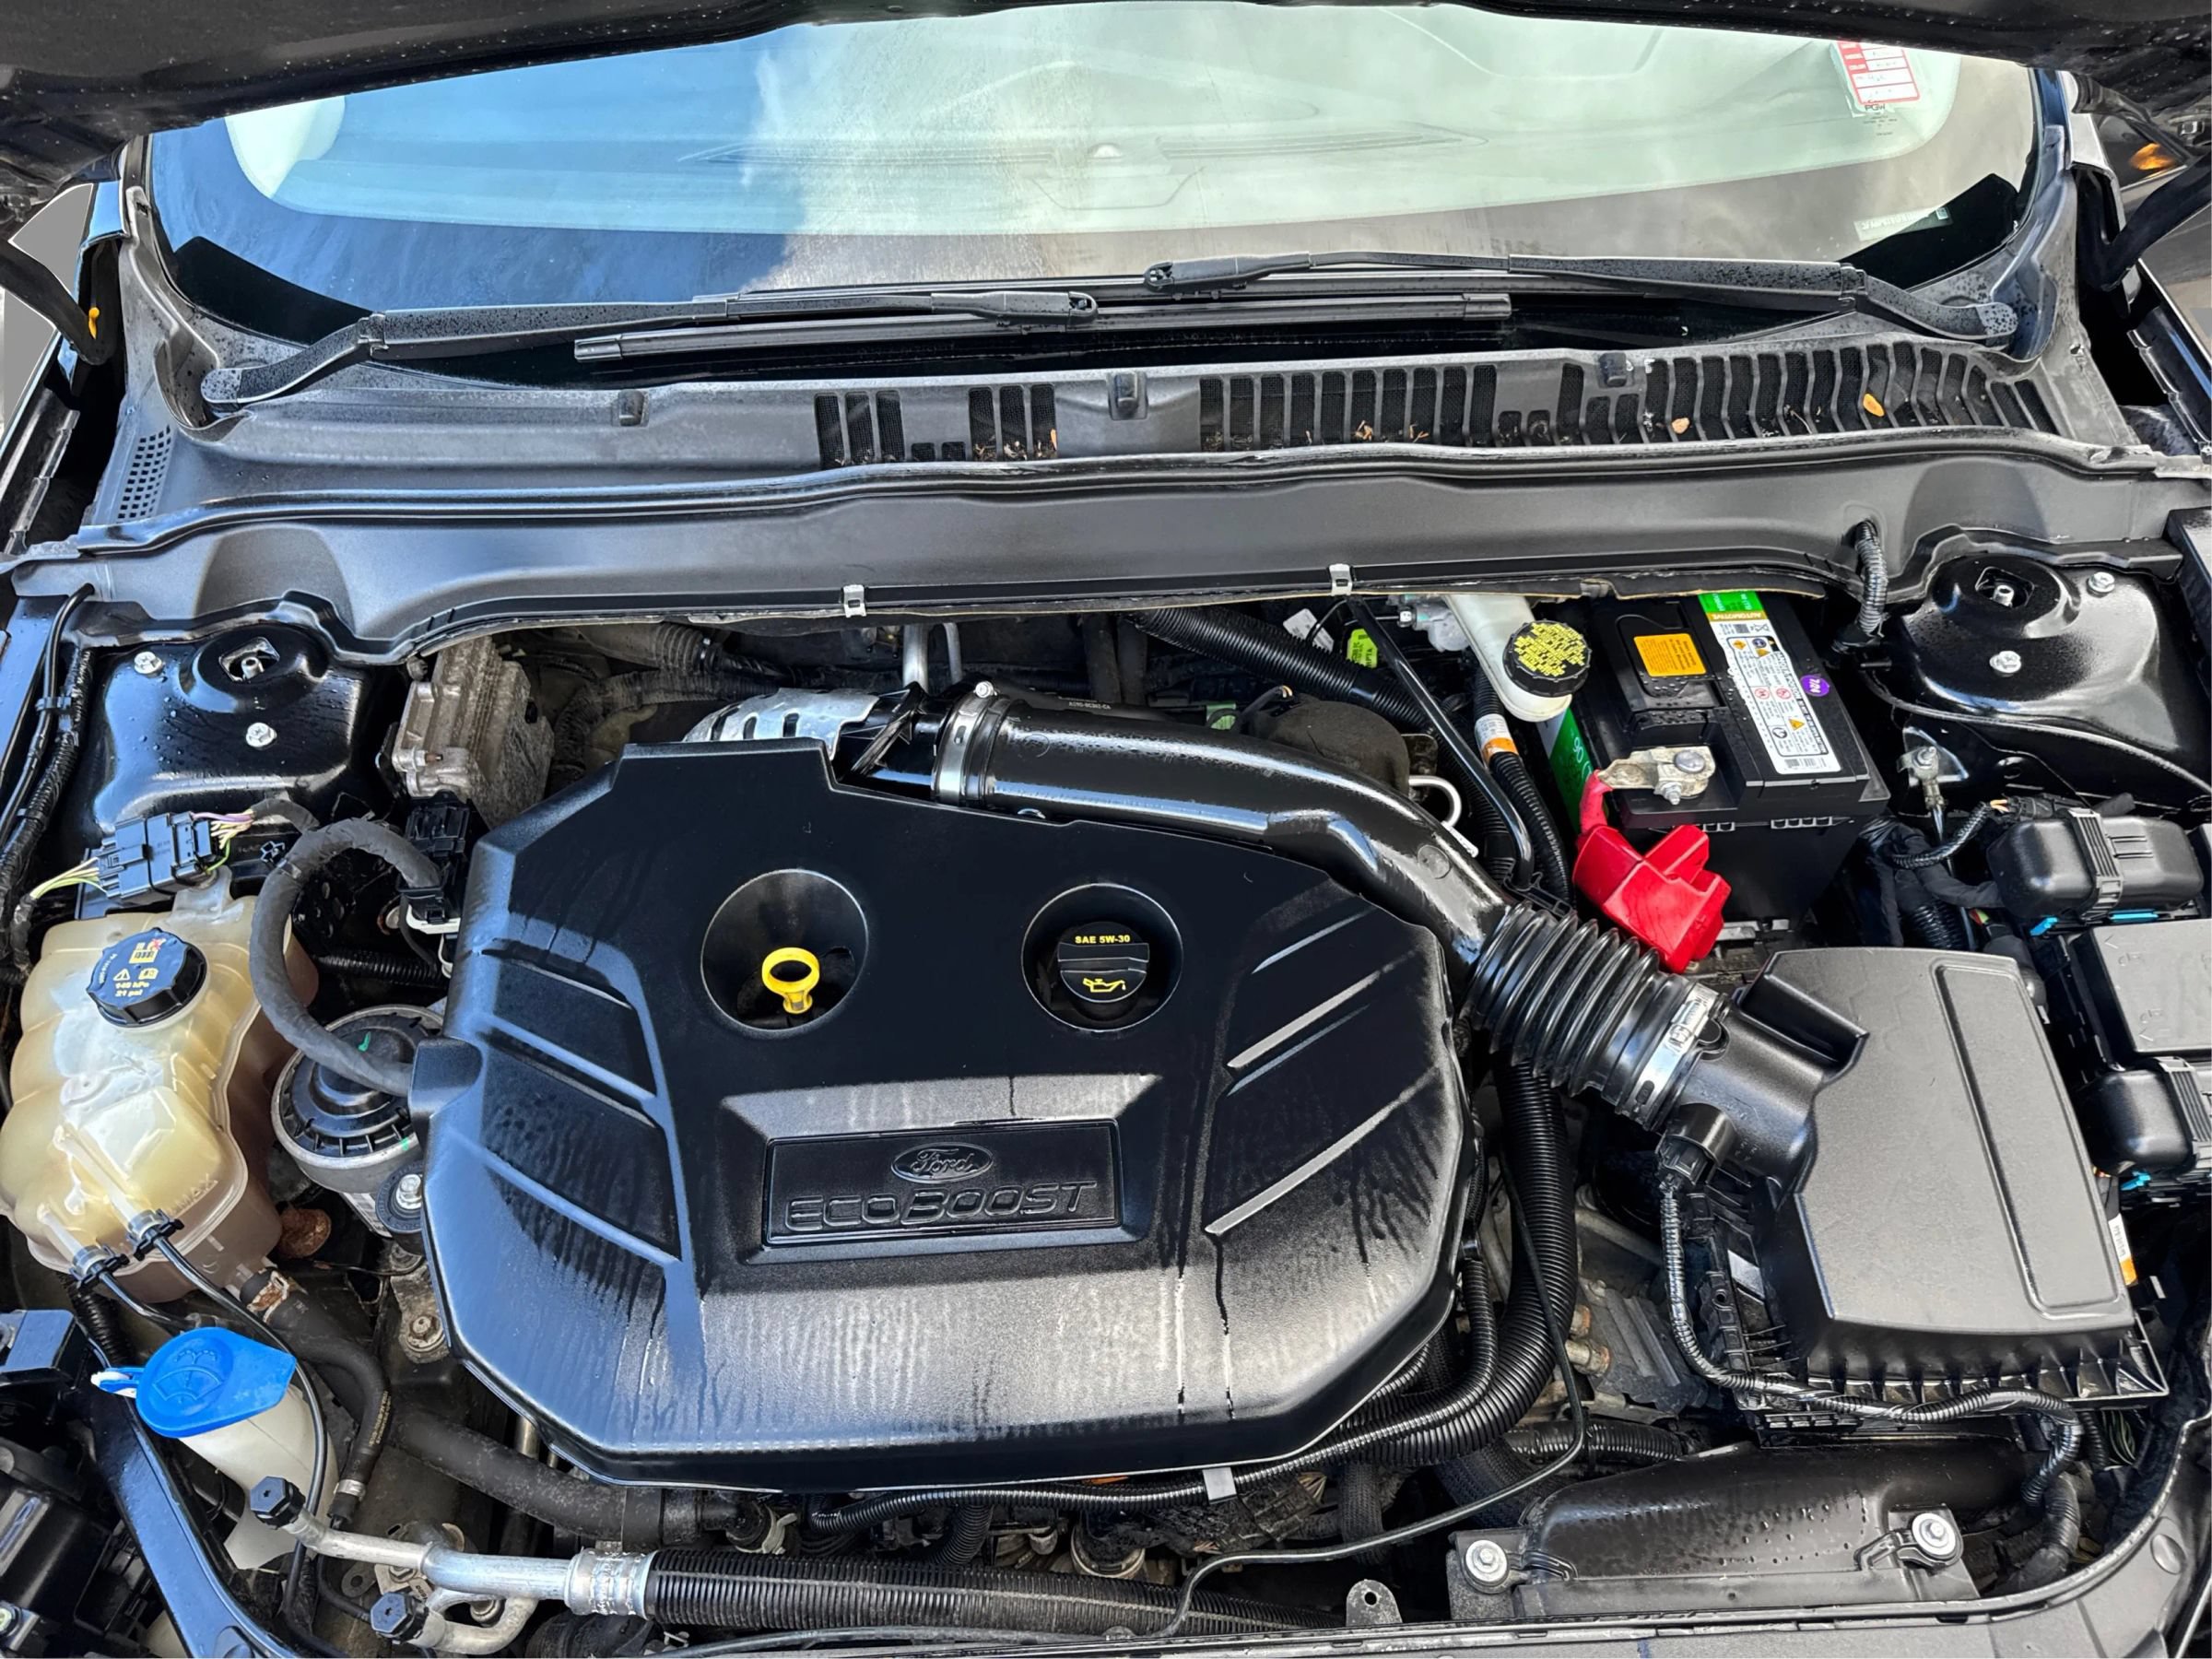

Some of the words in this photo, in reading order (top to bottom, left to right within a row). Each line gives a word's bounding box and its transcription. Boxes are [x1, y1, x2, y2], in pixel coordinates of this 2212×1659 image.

[1075, 935, 1097, 945] SAE
[1099, 934, 1131, 944] 5W-30
[911, 1147, 975, 1174] Ford
[784, 1180, 1098, 1232] ECOBOOST
